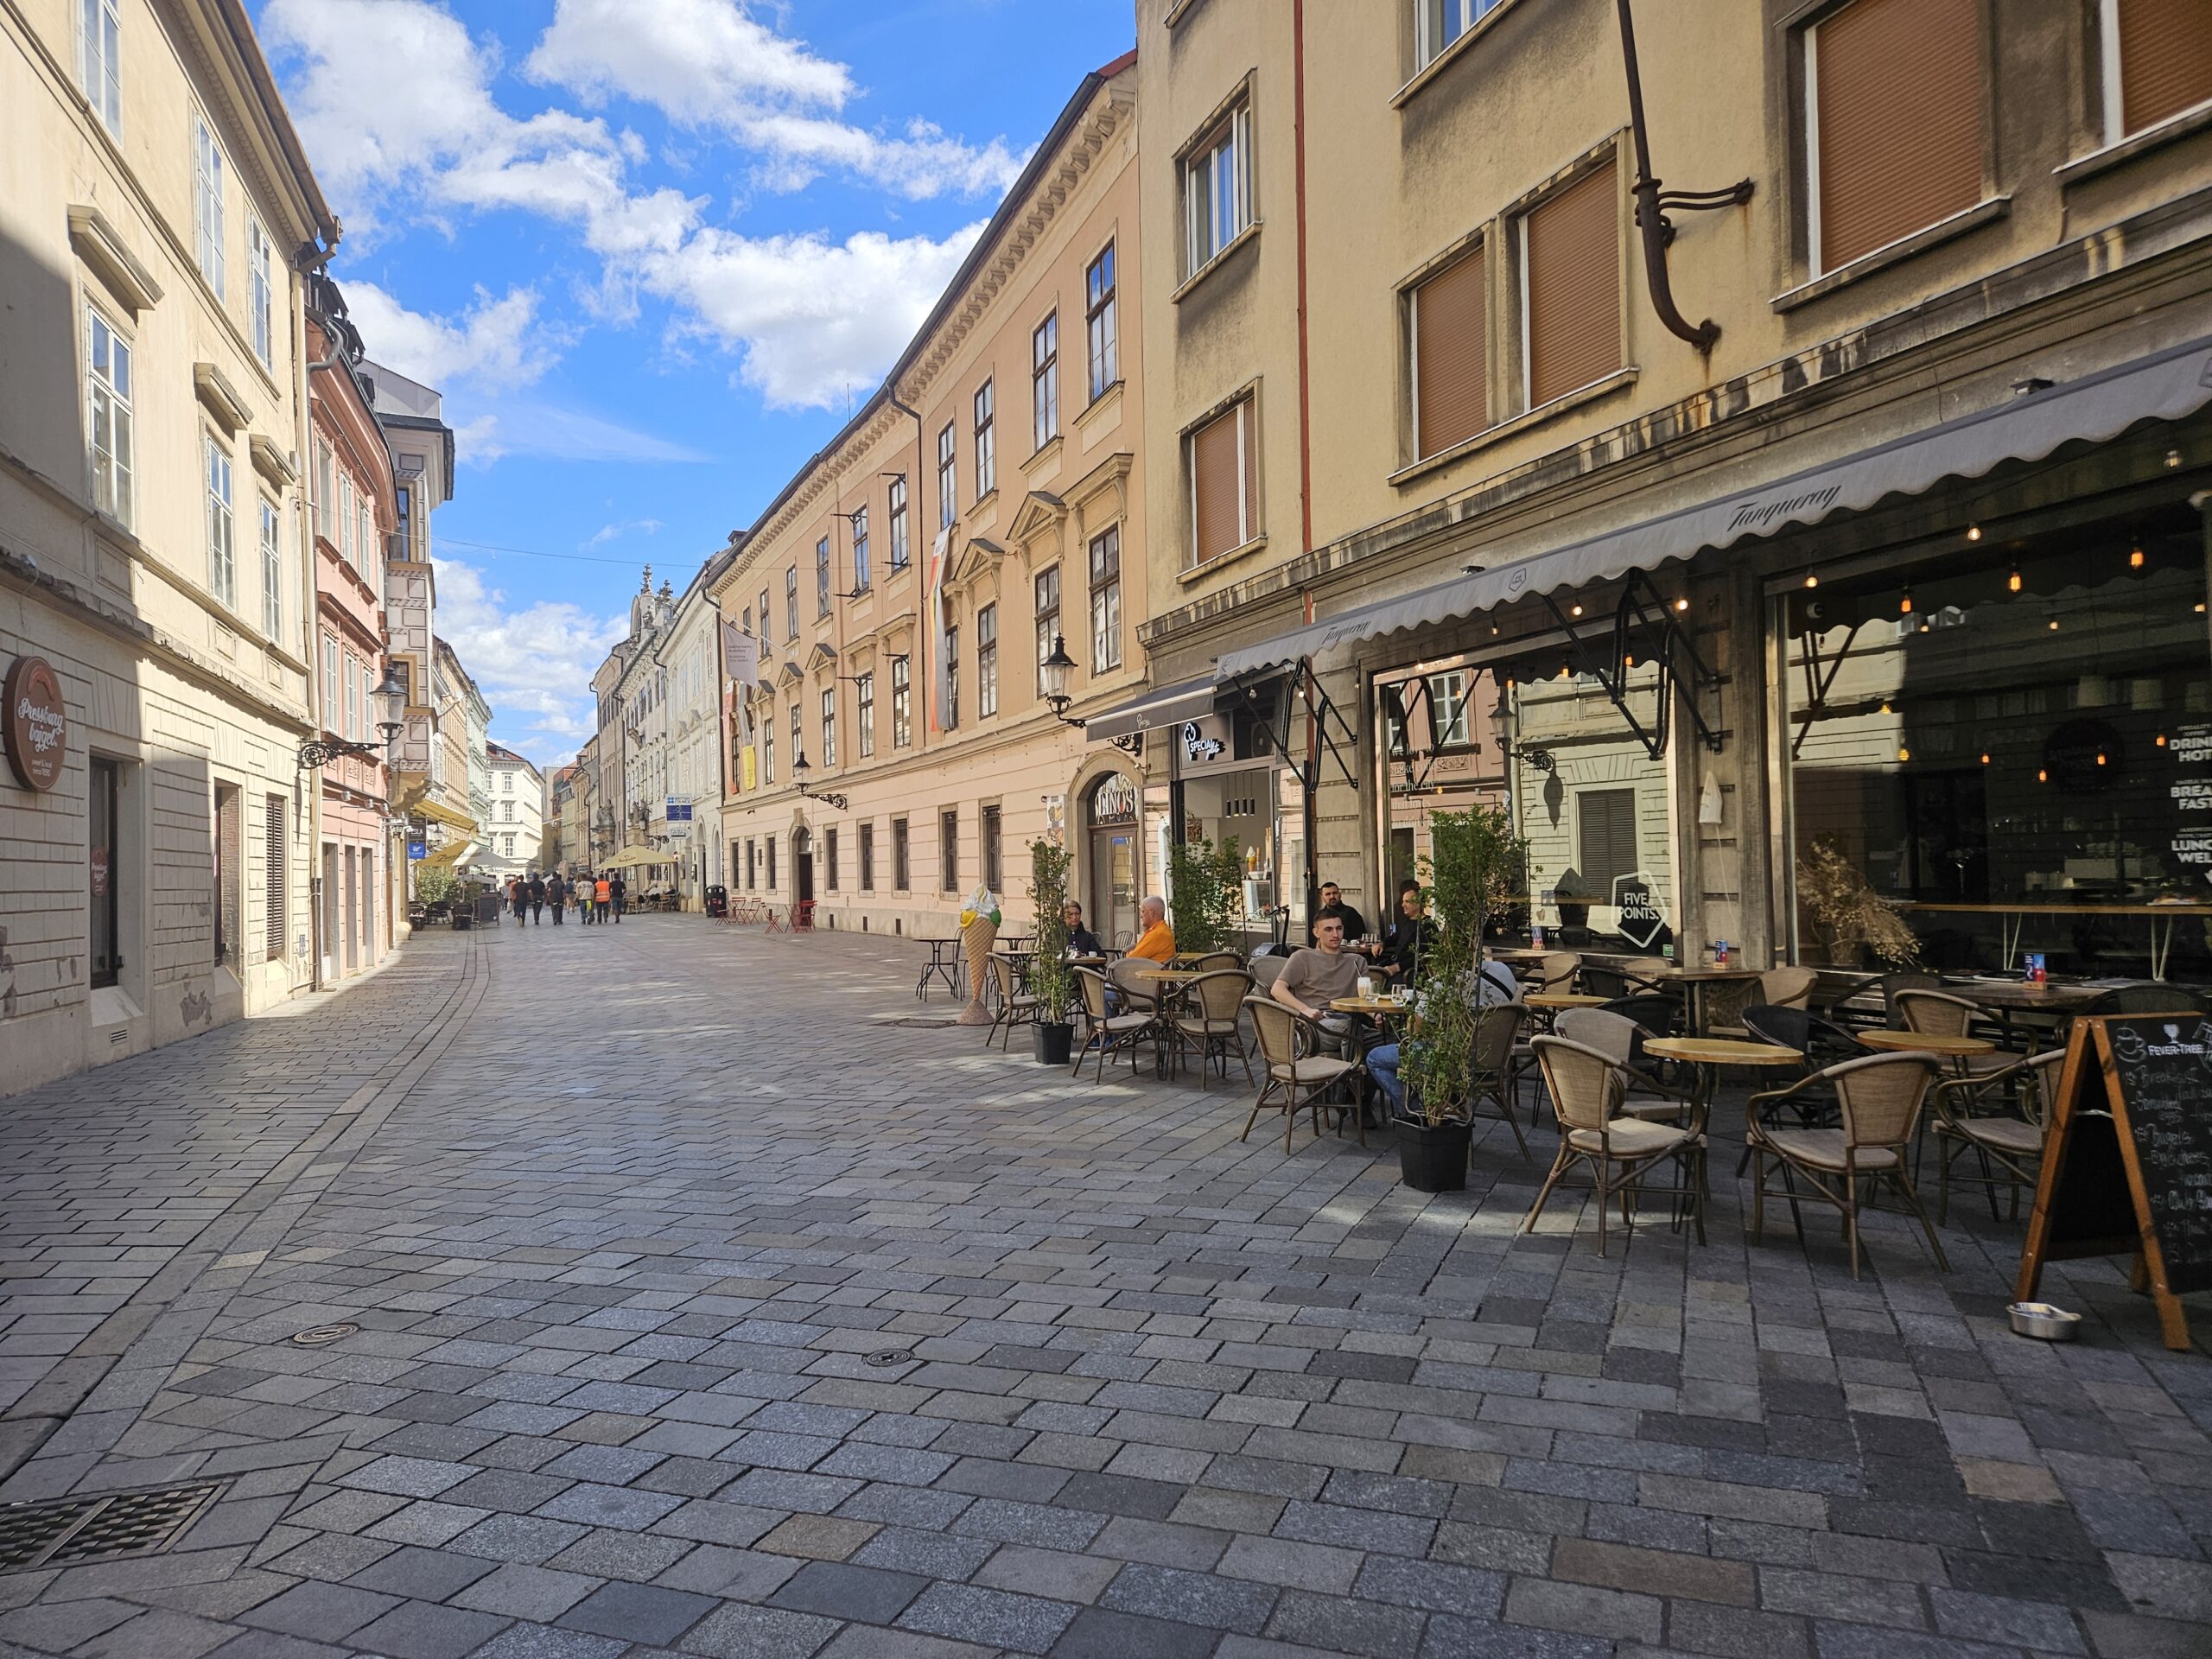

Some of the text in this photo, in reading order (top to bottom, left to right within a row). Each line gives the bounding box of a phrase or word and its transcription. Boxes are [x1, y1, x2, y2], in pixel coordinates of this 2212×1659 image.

[1727, 485, 1842, 532] Tanqueray
[1321, 620, 1372, 645] Tanqueray
[18, 698, 64, 735] Pressburg
[2170, 735, 2212, 751] DRIN
[1406, 779, 1417, 791] the
[1624, 892, 1648, 906] FIVE
[2147, 1043, 2204, 1056] FEVER-TREE
